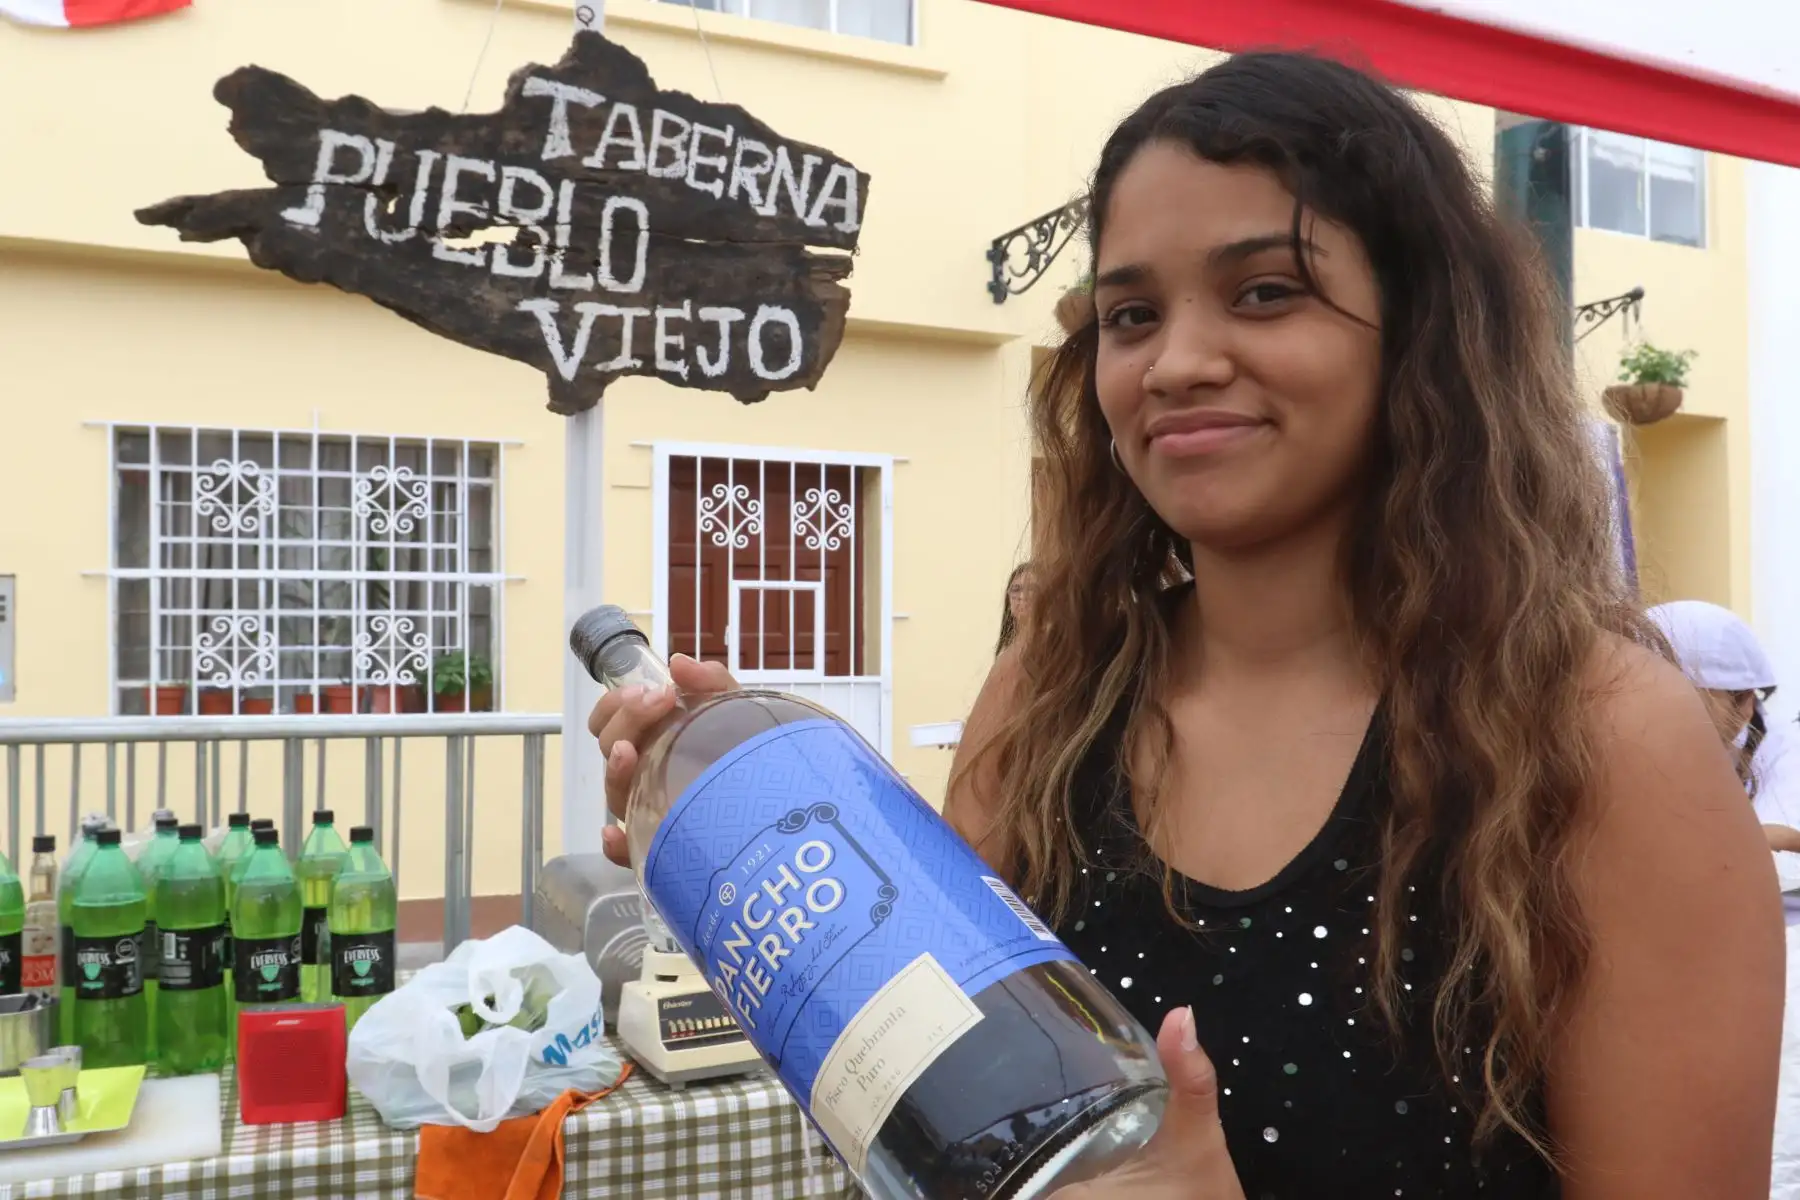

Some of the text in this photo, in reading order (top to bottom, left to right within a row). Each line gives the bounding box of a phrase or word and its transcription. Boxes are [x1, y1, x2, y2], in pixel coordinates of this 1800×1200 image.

[280, 128, 652, 293] PUEBLO
[522, 76, 862, 234] TABERNA
[516, 299, 804, 382] VIEJO
[714, 839, 835, 1007] PANCHO
[740, 842, 774, 876] 1921
[736, 876, 846, 1030] FIERRO
[824, 1004, 907, 1112] Pisco Quebranta
[855, 1056, 887, 1092] Puro
